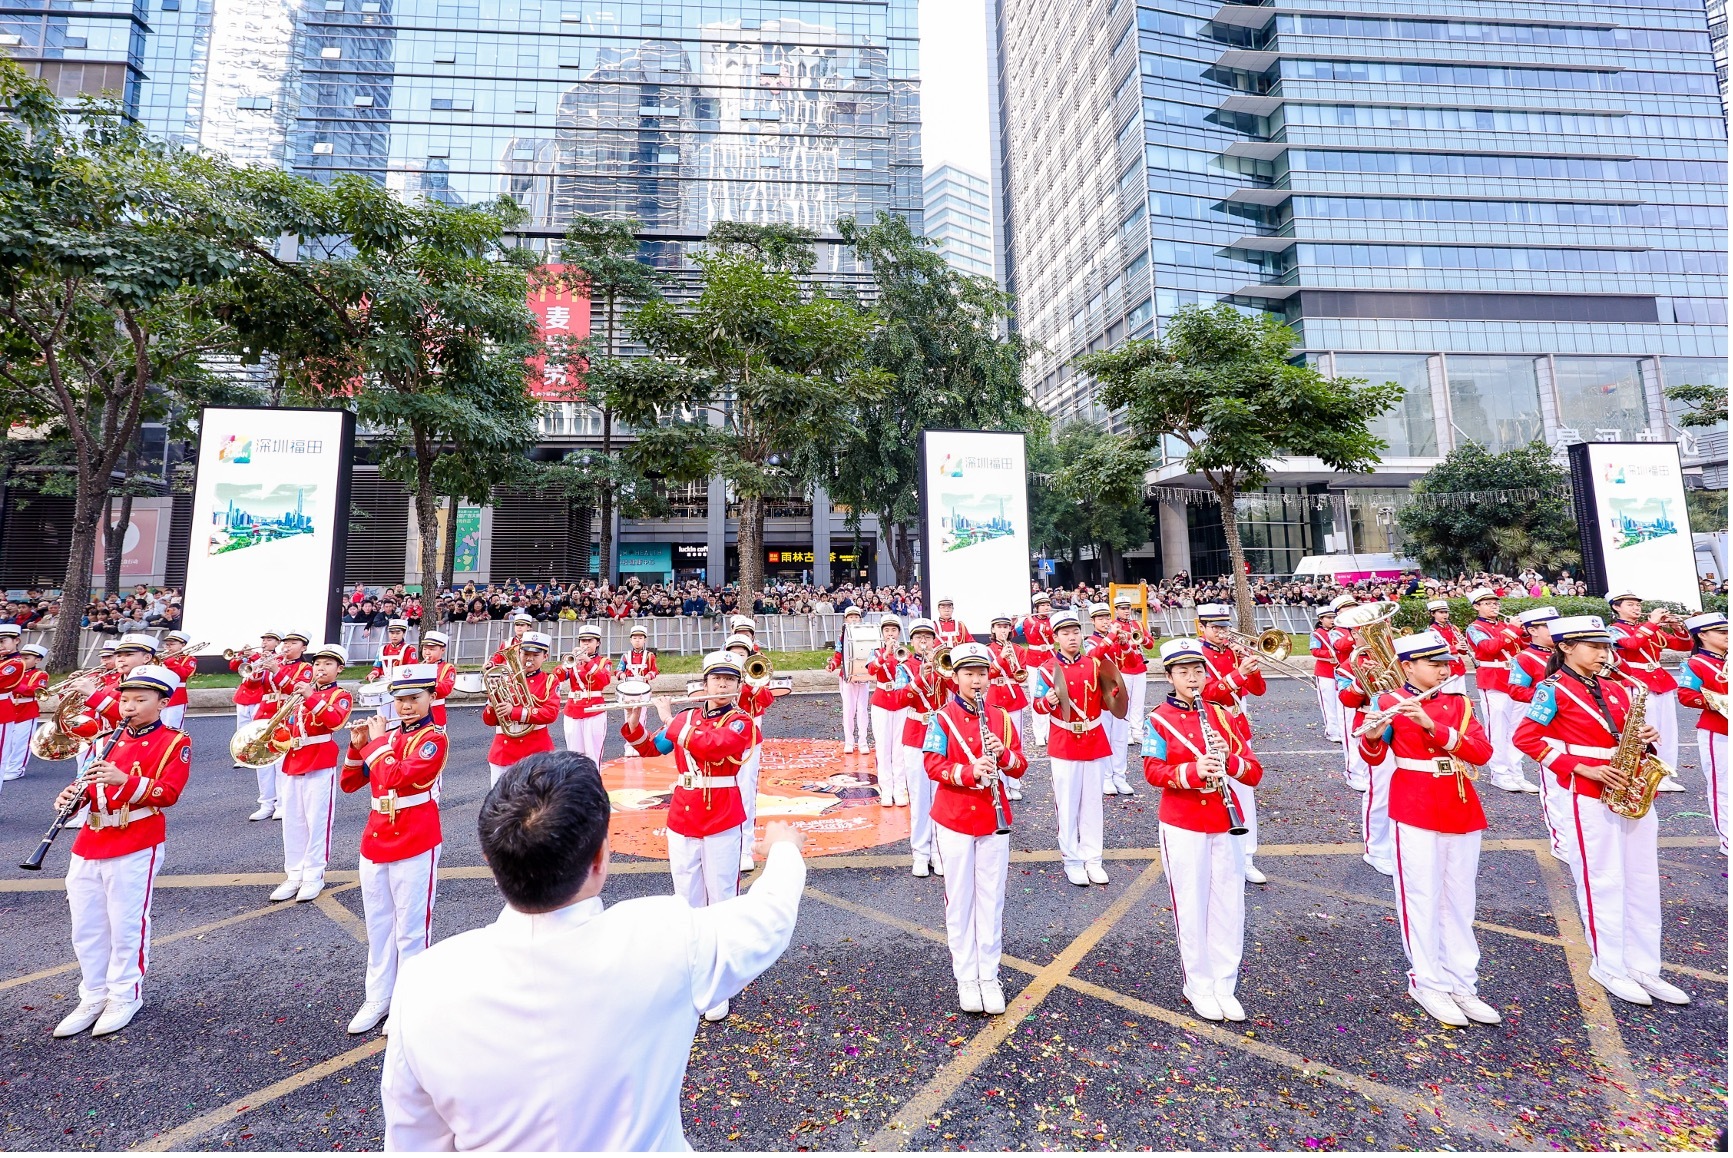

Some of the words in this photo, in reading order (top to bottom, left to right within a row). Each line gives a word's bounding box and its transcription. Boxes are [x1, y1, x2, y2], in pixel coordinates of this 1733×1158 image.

[256, 438, 323, 454] 深圳福田
[965, 456, 1013, 470] 深圳福田
[697, 545, 709, 553] coff
[781, 551, 837, 563] 雨林古茶
